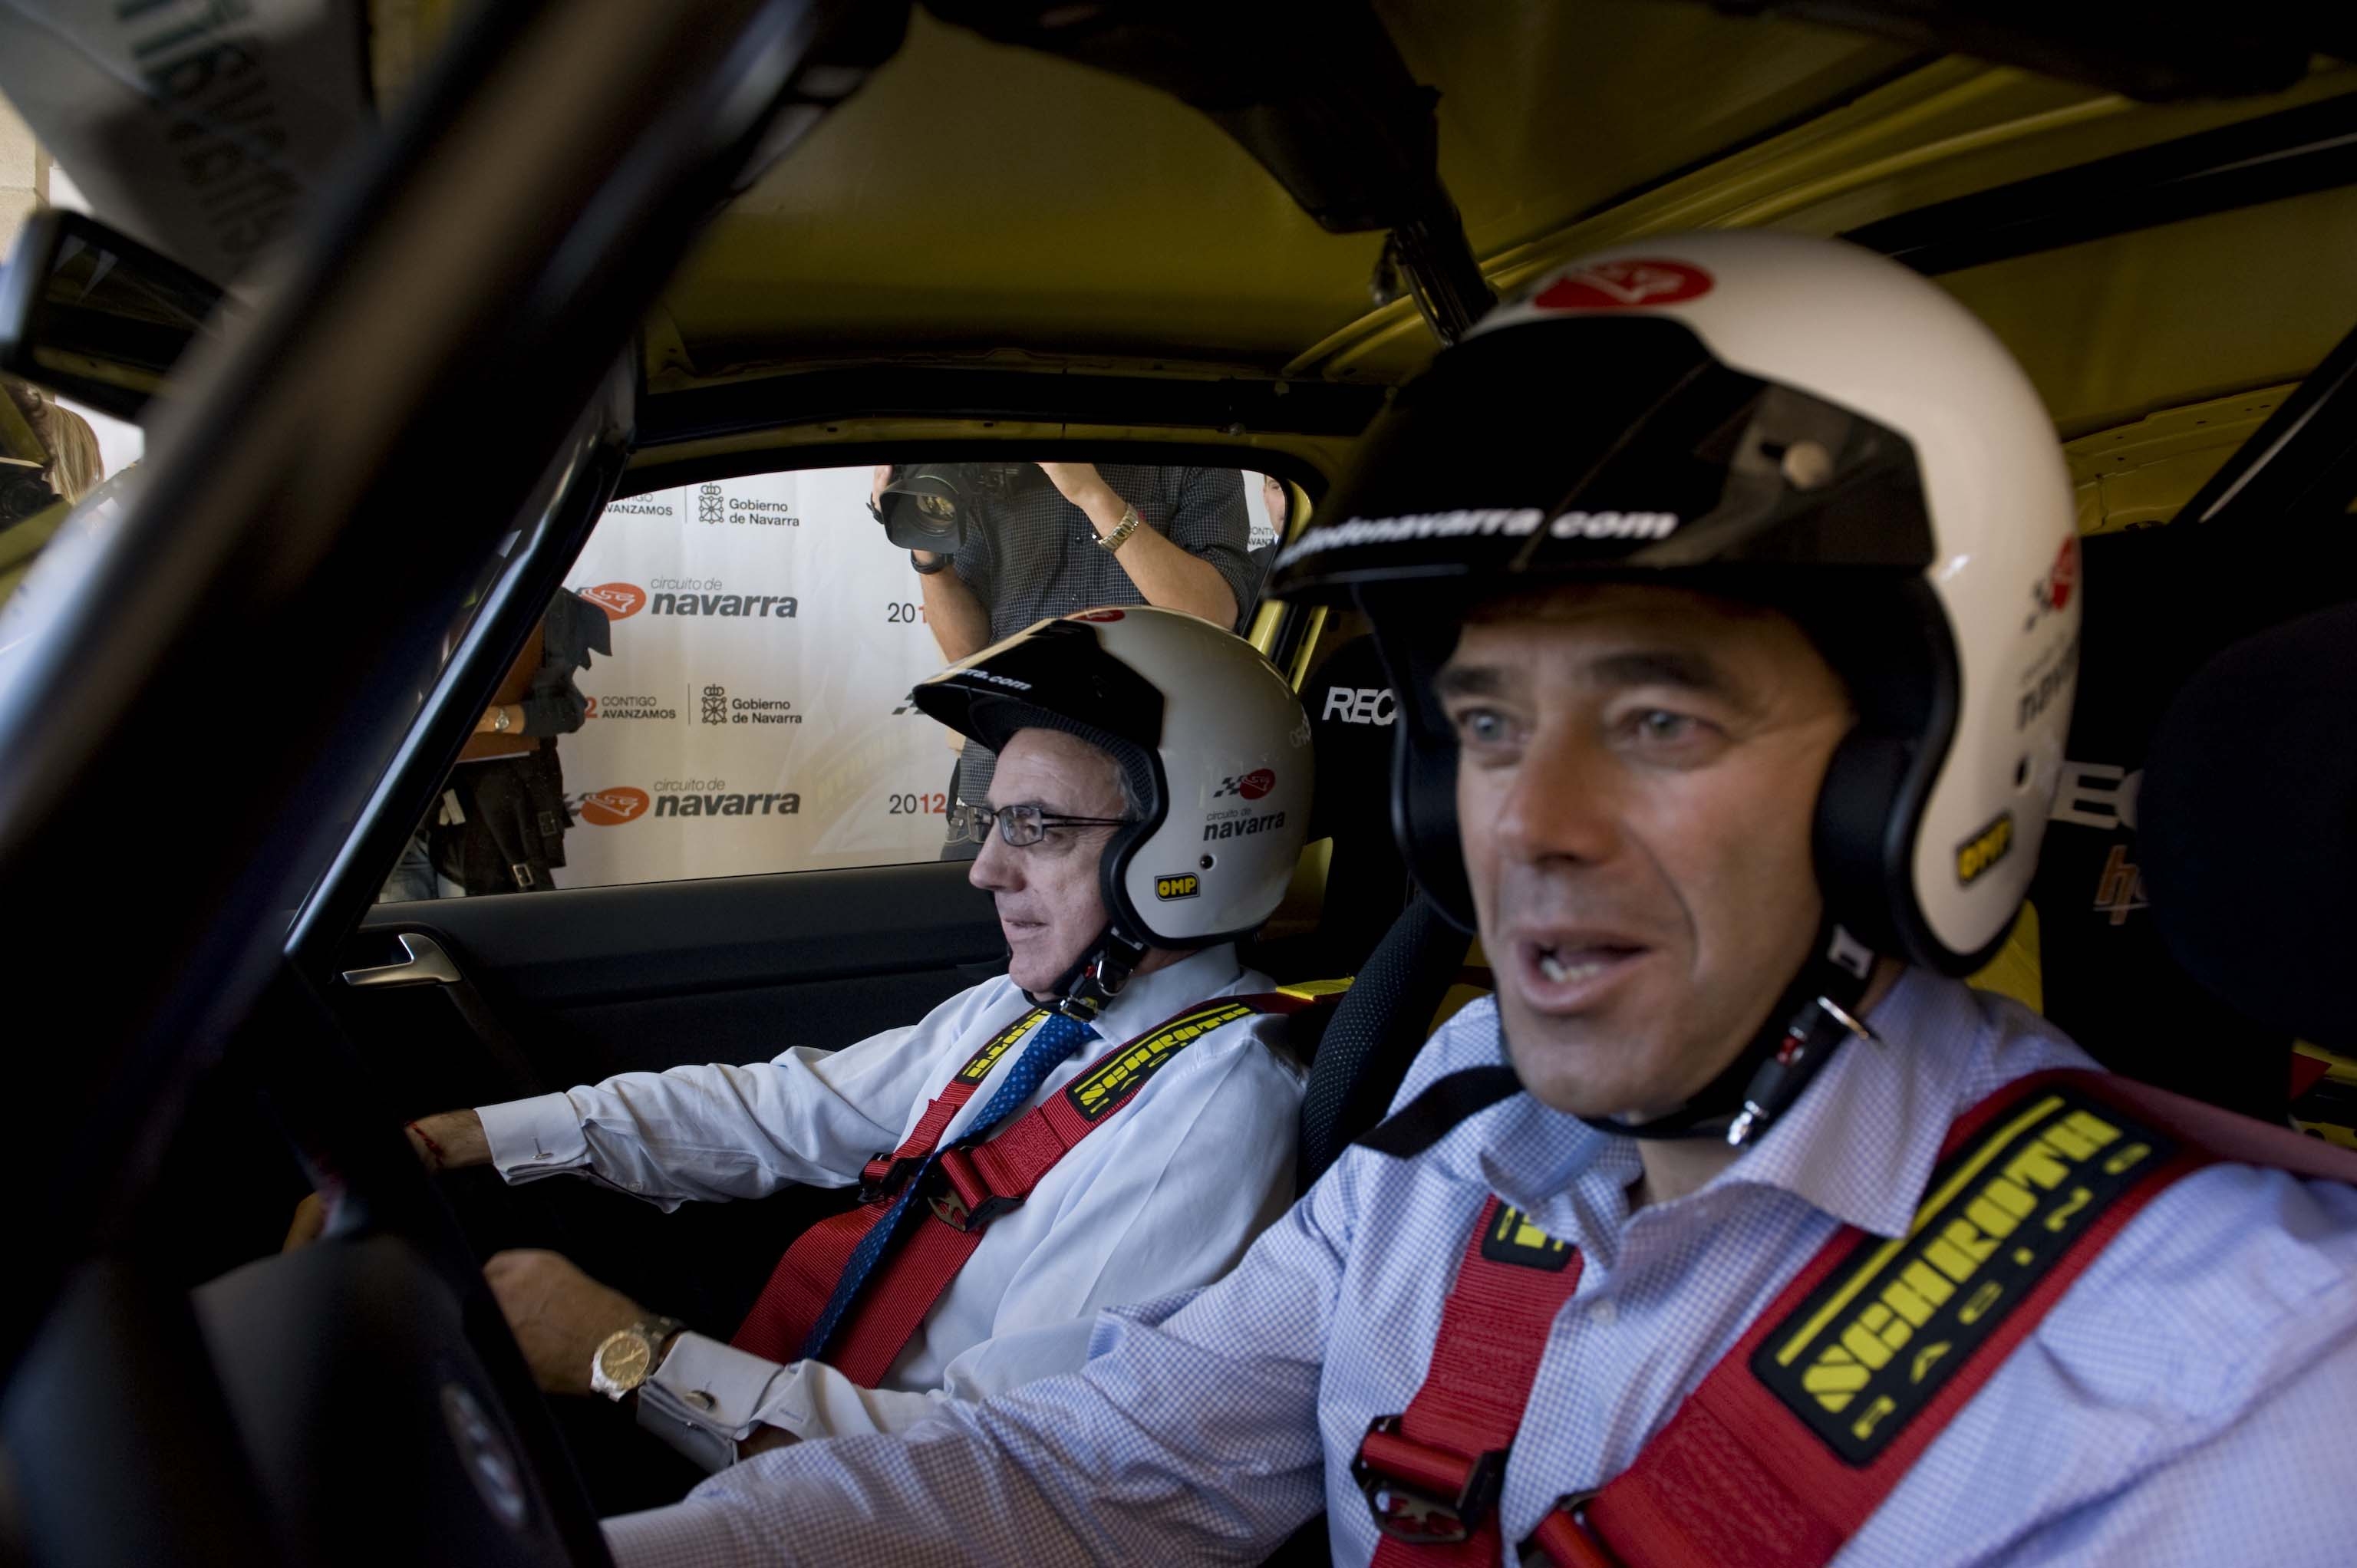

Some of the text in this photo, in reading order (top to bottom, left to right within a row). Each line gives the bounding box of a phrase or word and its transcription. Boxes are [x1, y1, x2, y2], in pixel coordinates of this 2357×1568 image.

[605, 504, 673, 516] VANZAMOS
[729, 499, 788, 512] Gobierno
[729, 512, 799, 527] de Navarra
[650, 575, 723, 591] circuito de
[652, 592, 798, 618] navarra
[888, 602, 927, 624] 201
[602, 695, 657, 707] CONTIGO
[732, 697, 790, 710] Gobierno
[1322, 686, 1399, 726] REC
[602, 708, 677, 720] AVANZAMOS
[732, 712, 802, 723] de Navarra
[654, 776, 725, 792] circuito de
[654, 792, 800, 818] navarra
[889, 793, 947, 814] 2012
[1203, 811, 1286, 842] navarra
[1159, 877, 1196, 897] OMP
[1080, 1006, 1251, 1106] SCHROTH
[1802, 1109, 2123, 1413] SCHROTH
